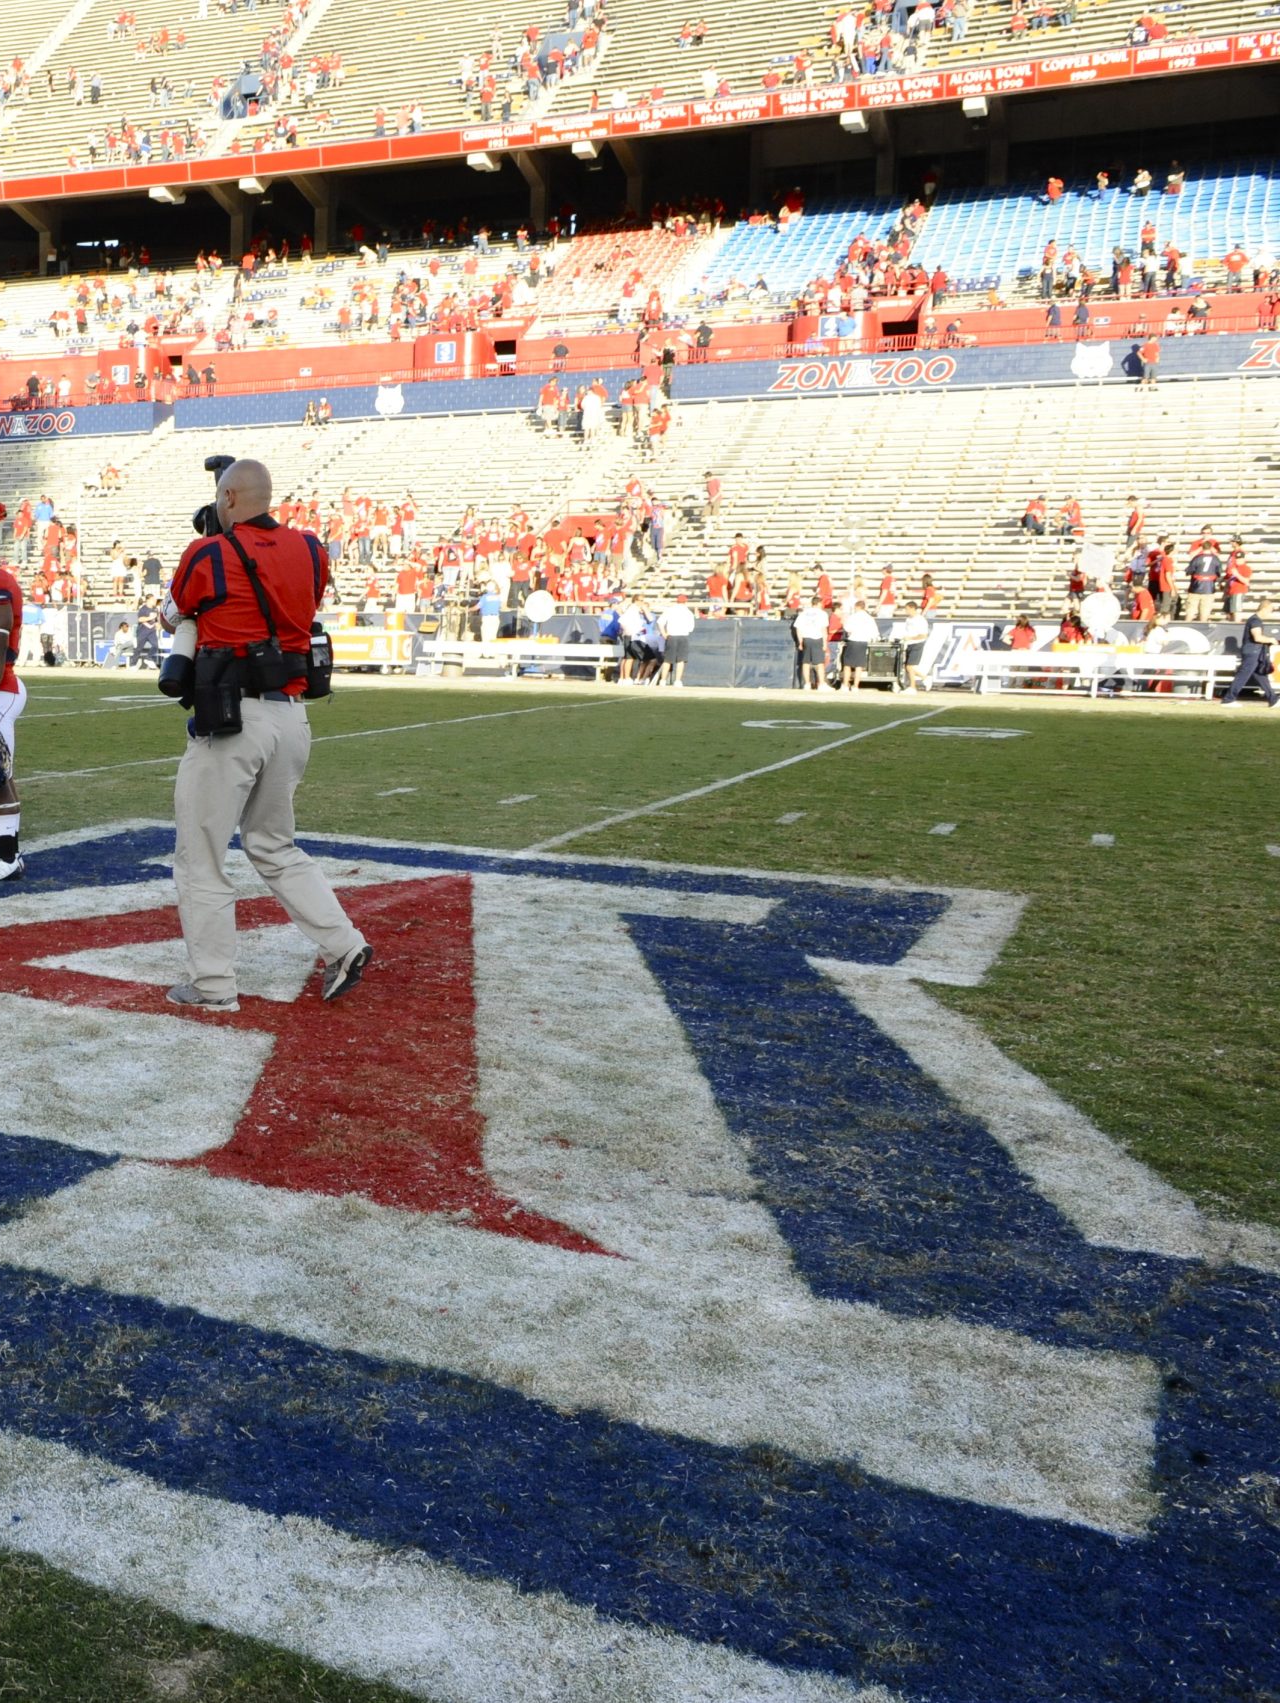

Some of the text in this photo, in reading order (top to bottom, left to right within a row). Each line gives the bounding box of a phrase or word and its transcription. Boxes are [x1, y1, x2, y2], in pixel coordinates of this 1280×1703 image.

[1203, 39, 1229, 54] BOWL
[1041, 50, 1129, 73] COPPER BOWL
[1168, 57, 1196, 70] 1992
[950, 64, 1032, 85] ALOHA BOWL
[860, 75, 940, 96] FIESTA BOWL
[714, 96, 767, 112] CHAMPIONS
[779, 86, 848, 104] SUN BOWL
[614, 105, 686, 124] SALAD BOWL
